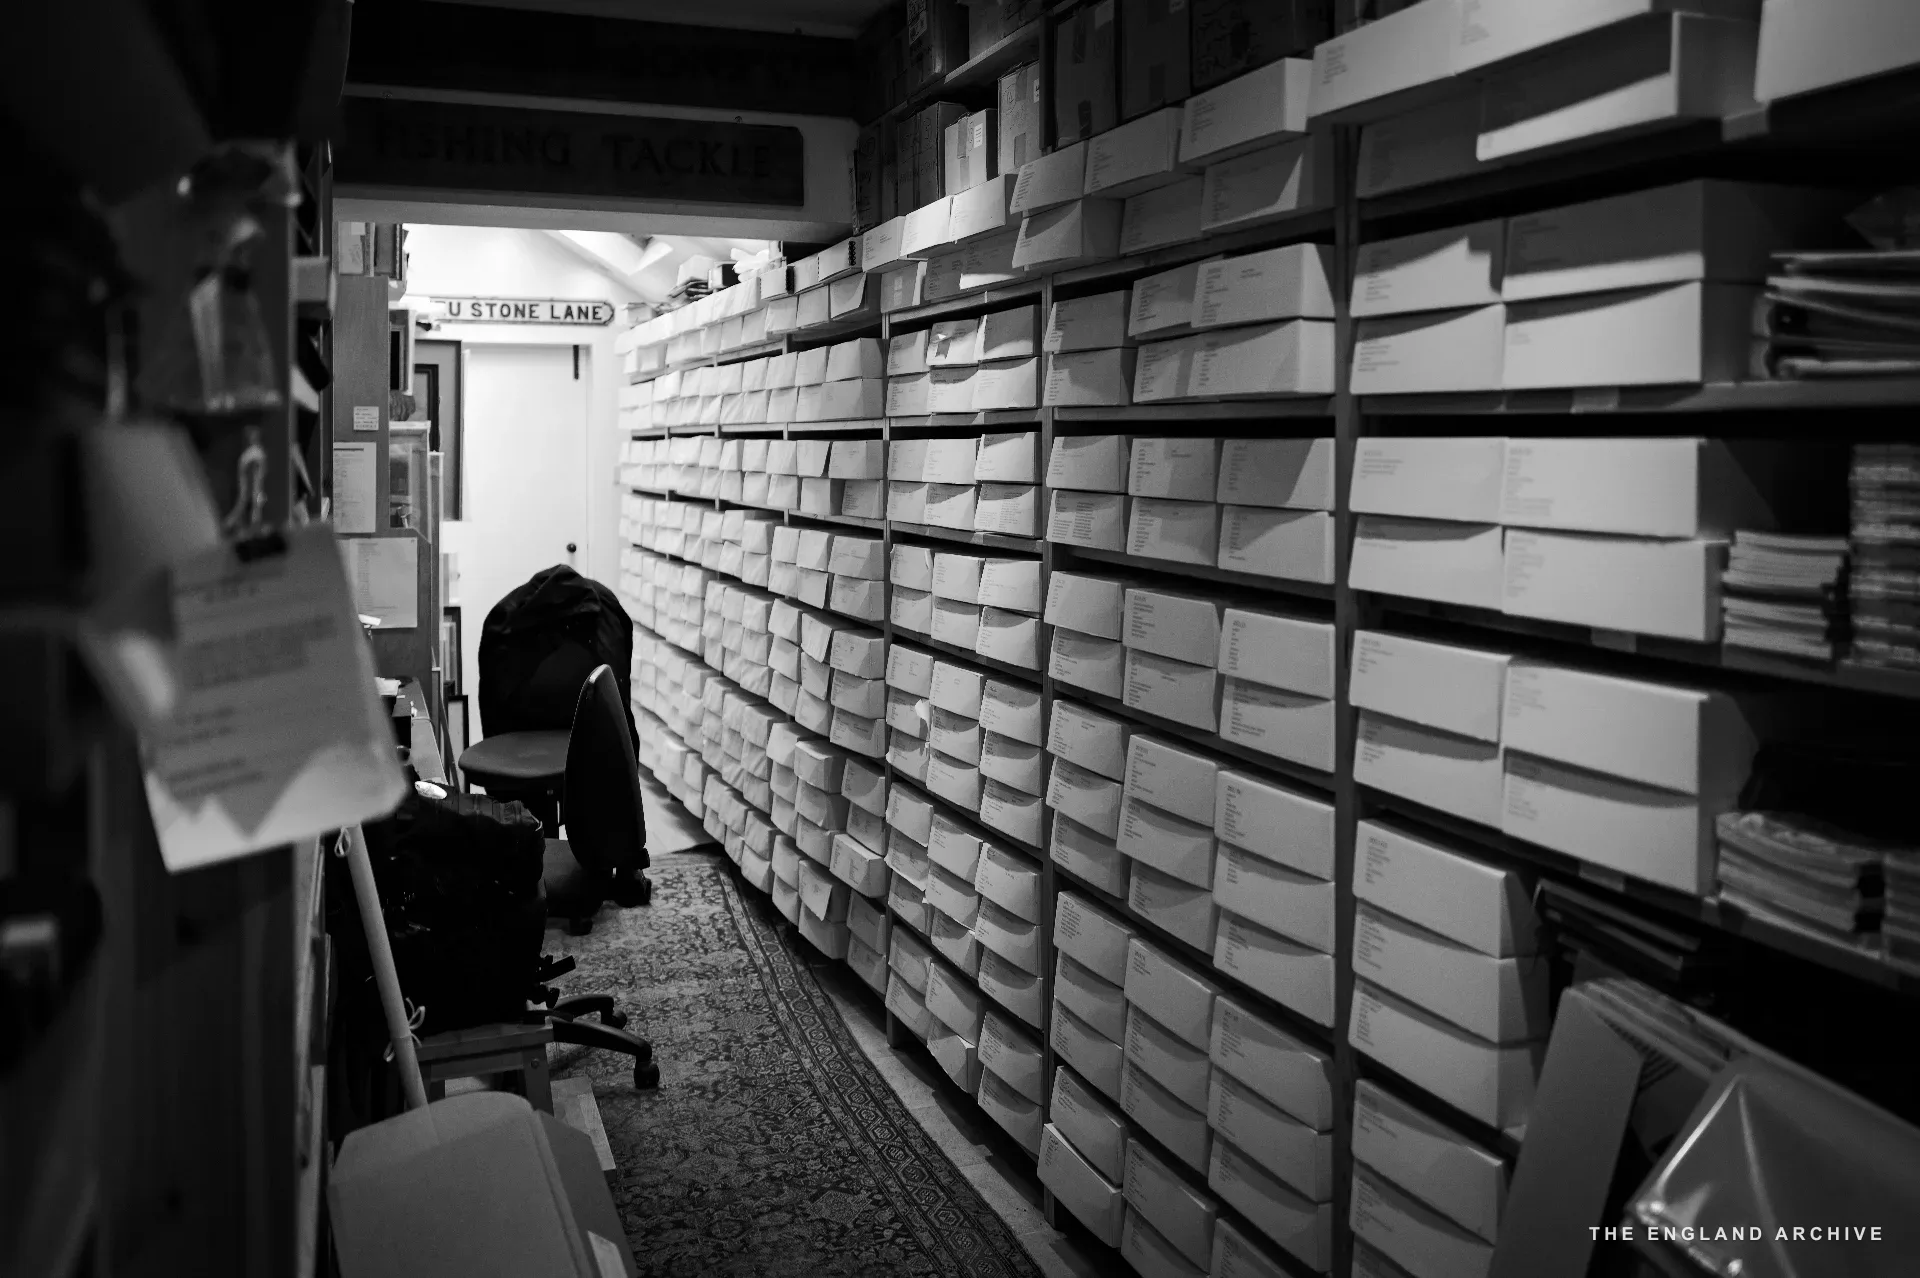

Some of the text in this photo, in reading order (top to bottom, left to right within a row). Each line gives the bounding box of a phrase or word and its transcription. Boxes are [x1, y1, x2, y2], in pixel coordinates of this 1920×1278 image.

[375, 117, 771, 178] FISHING TACKLE
[471, 303, 540, 319] STONE
[550, 304, 603, 320] LANE
